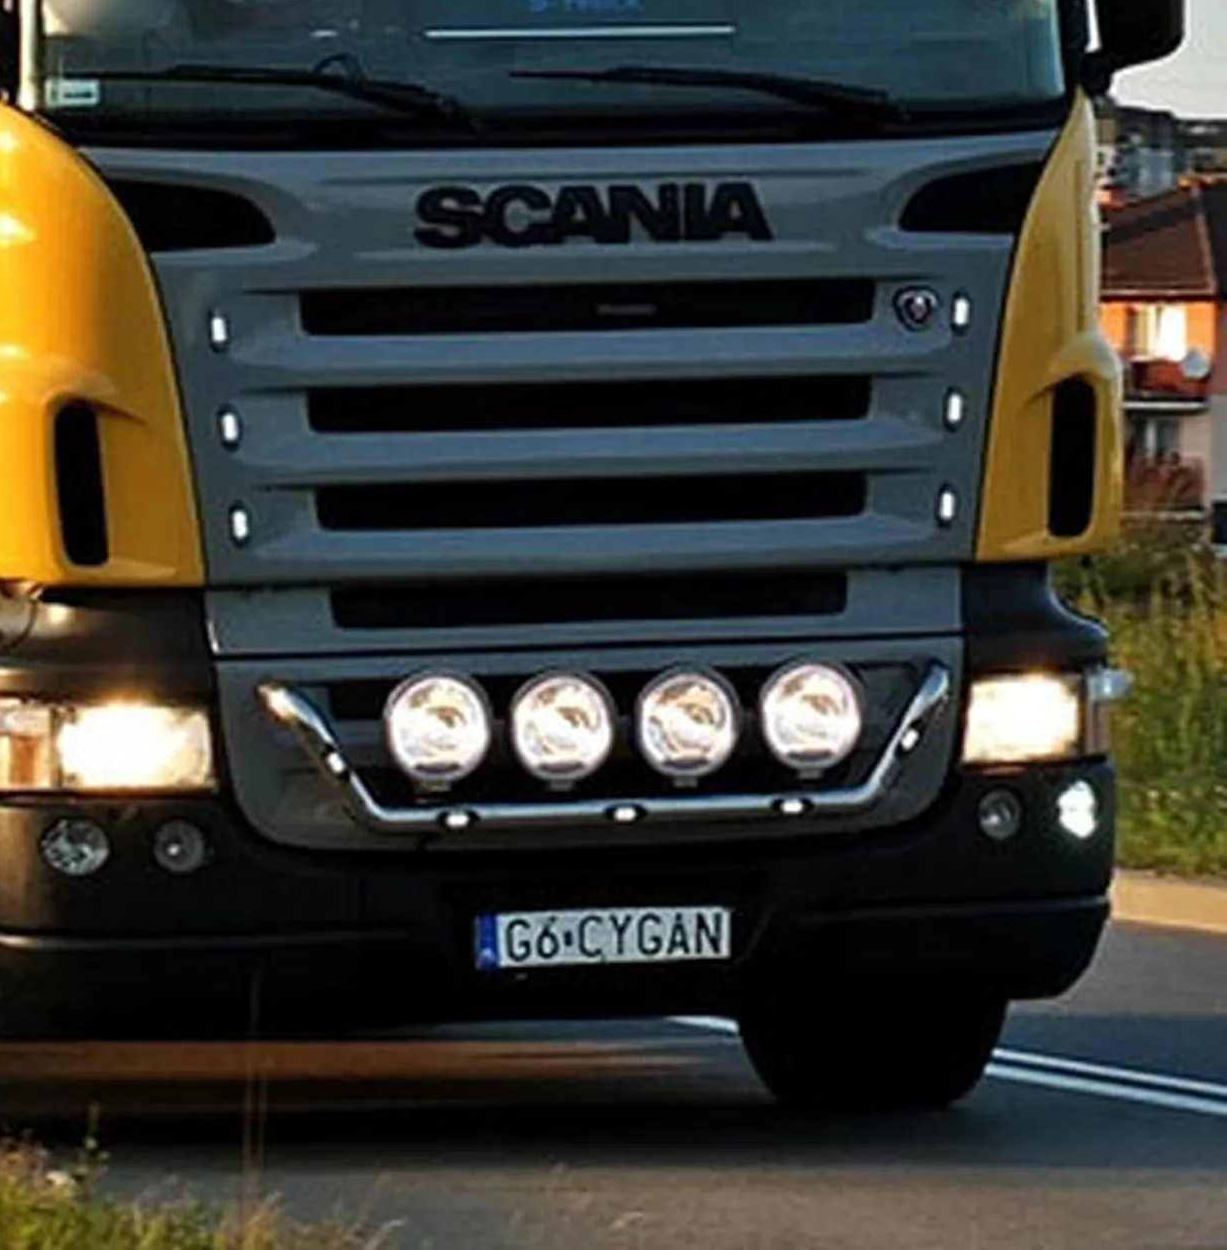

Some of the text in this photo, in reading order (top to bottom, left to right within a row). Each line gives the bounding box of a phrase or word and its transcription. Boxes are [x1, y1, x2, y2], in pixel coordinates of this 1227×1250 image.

[413, 181, 775, 249] SCANIA
[505, 912, 724, 962] G6 CYGAN
